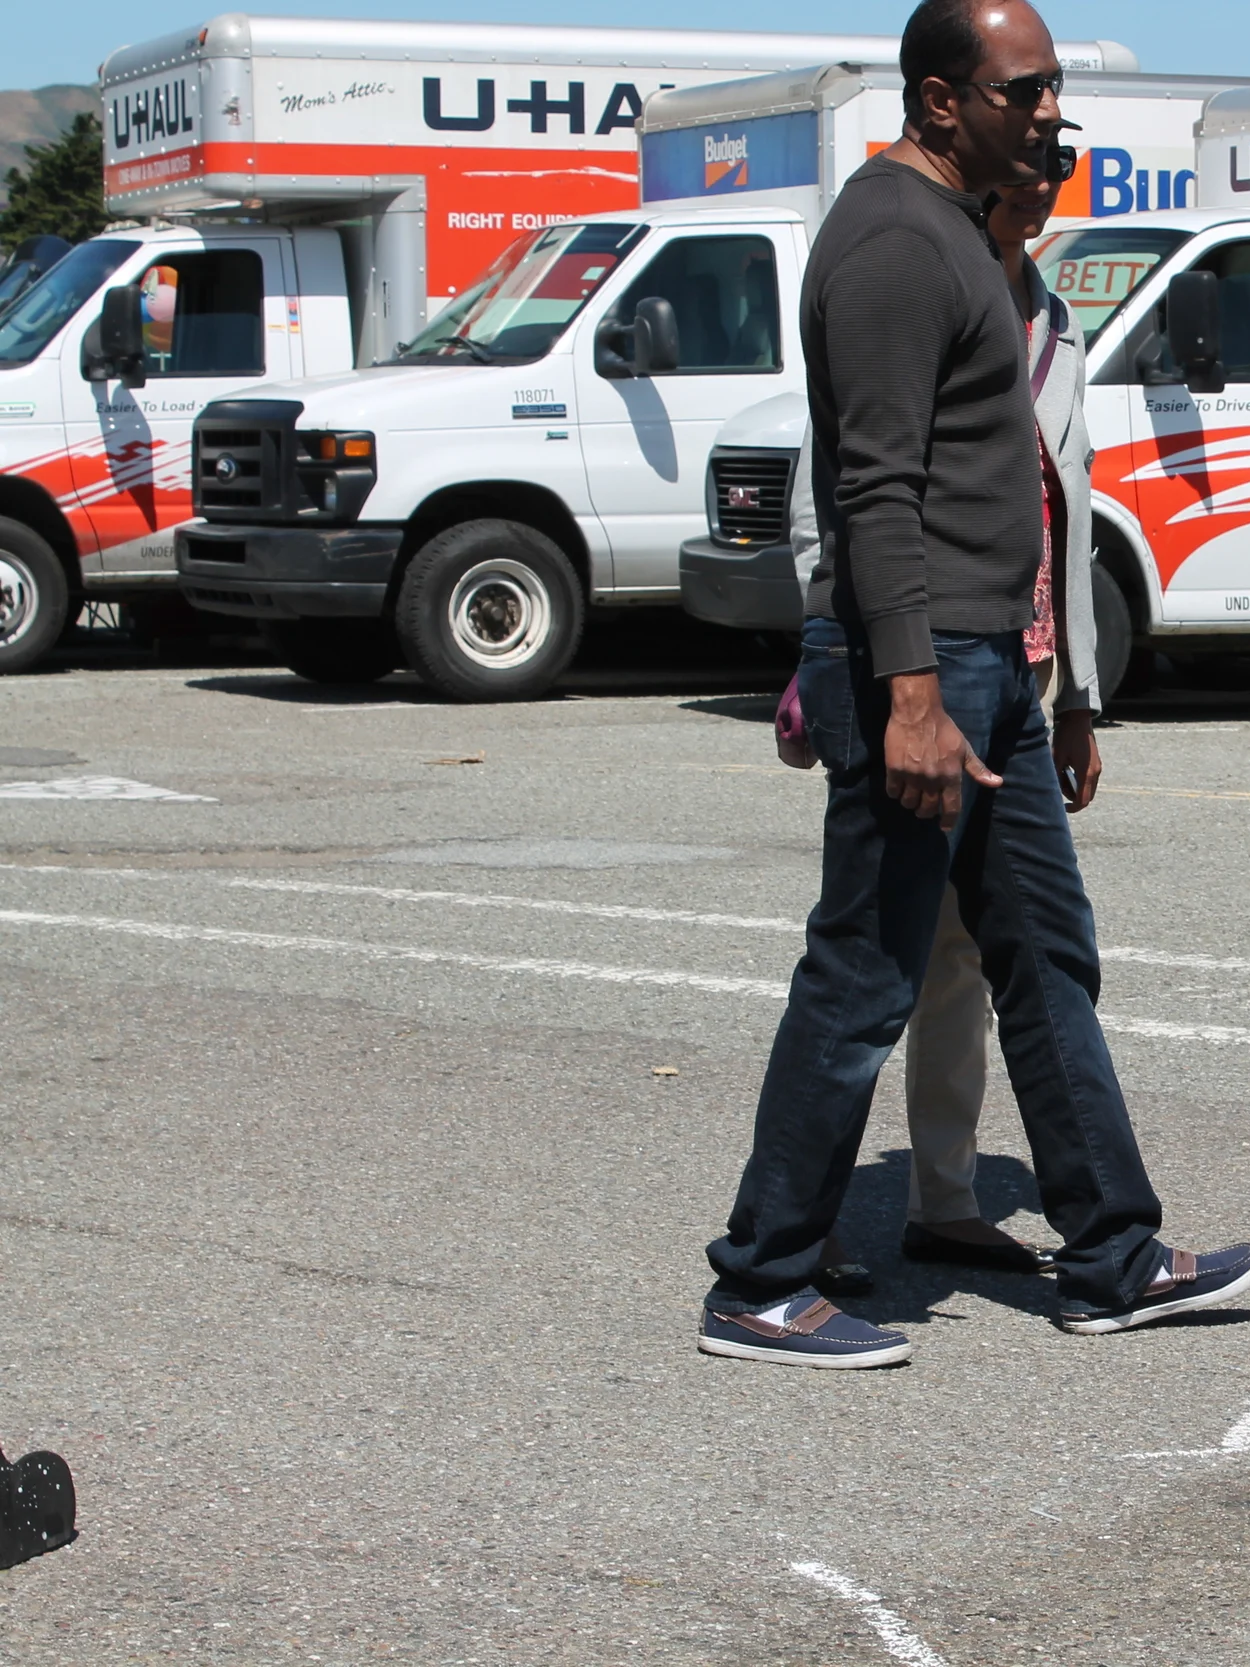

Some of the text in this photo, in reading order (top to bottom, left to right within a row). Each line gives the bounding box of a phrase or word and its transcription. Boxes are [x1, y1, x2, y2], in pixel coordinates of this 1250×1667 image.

[281, 81, 387, 113] Mom's Attic
[423, 77, 676, 135] U-HA
[113, 79, 193, 149] U-HAUL
[704, 133, 748, 167] Budget
[448, 212, 505, 229] RIGHT
[1055, 261, 1156, 294] BETT
[96, 400, 195, 414] Easier To Load
[514, 388, 555, 403] 118071
[1145, 400, 1190, 412] Easier
[1196, 400, 1210, 412] To
